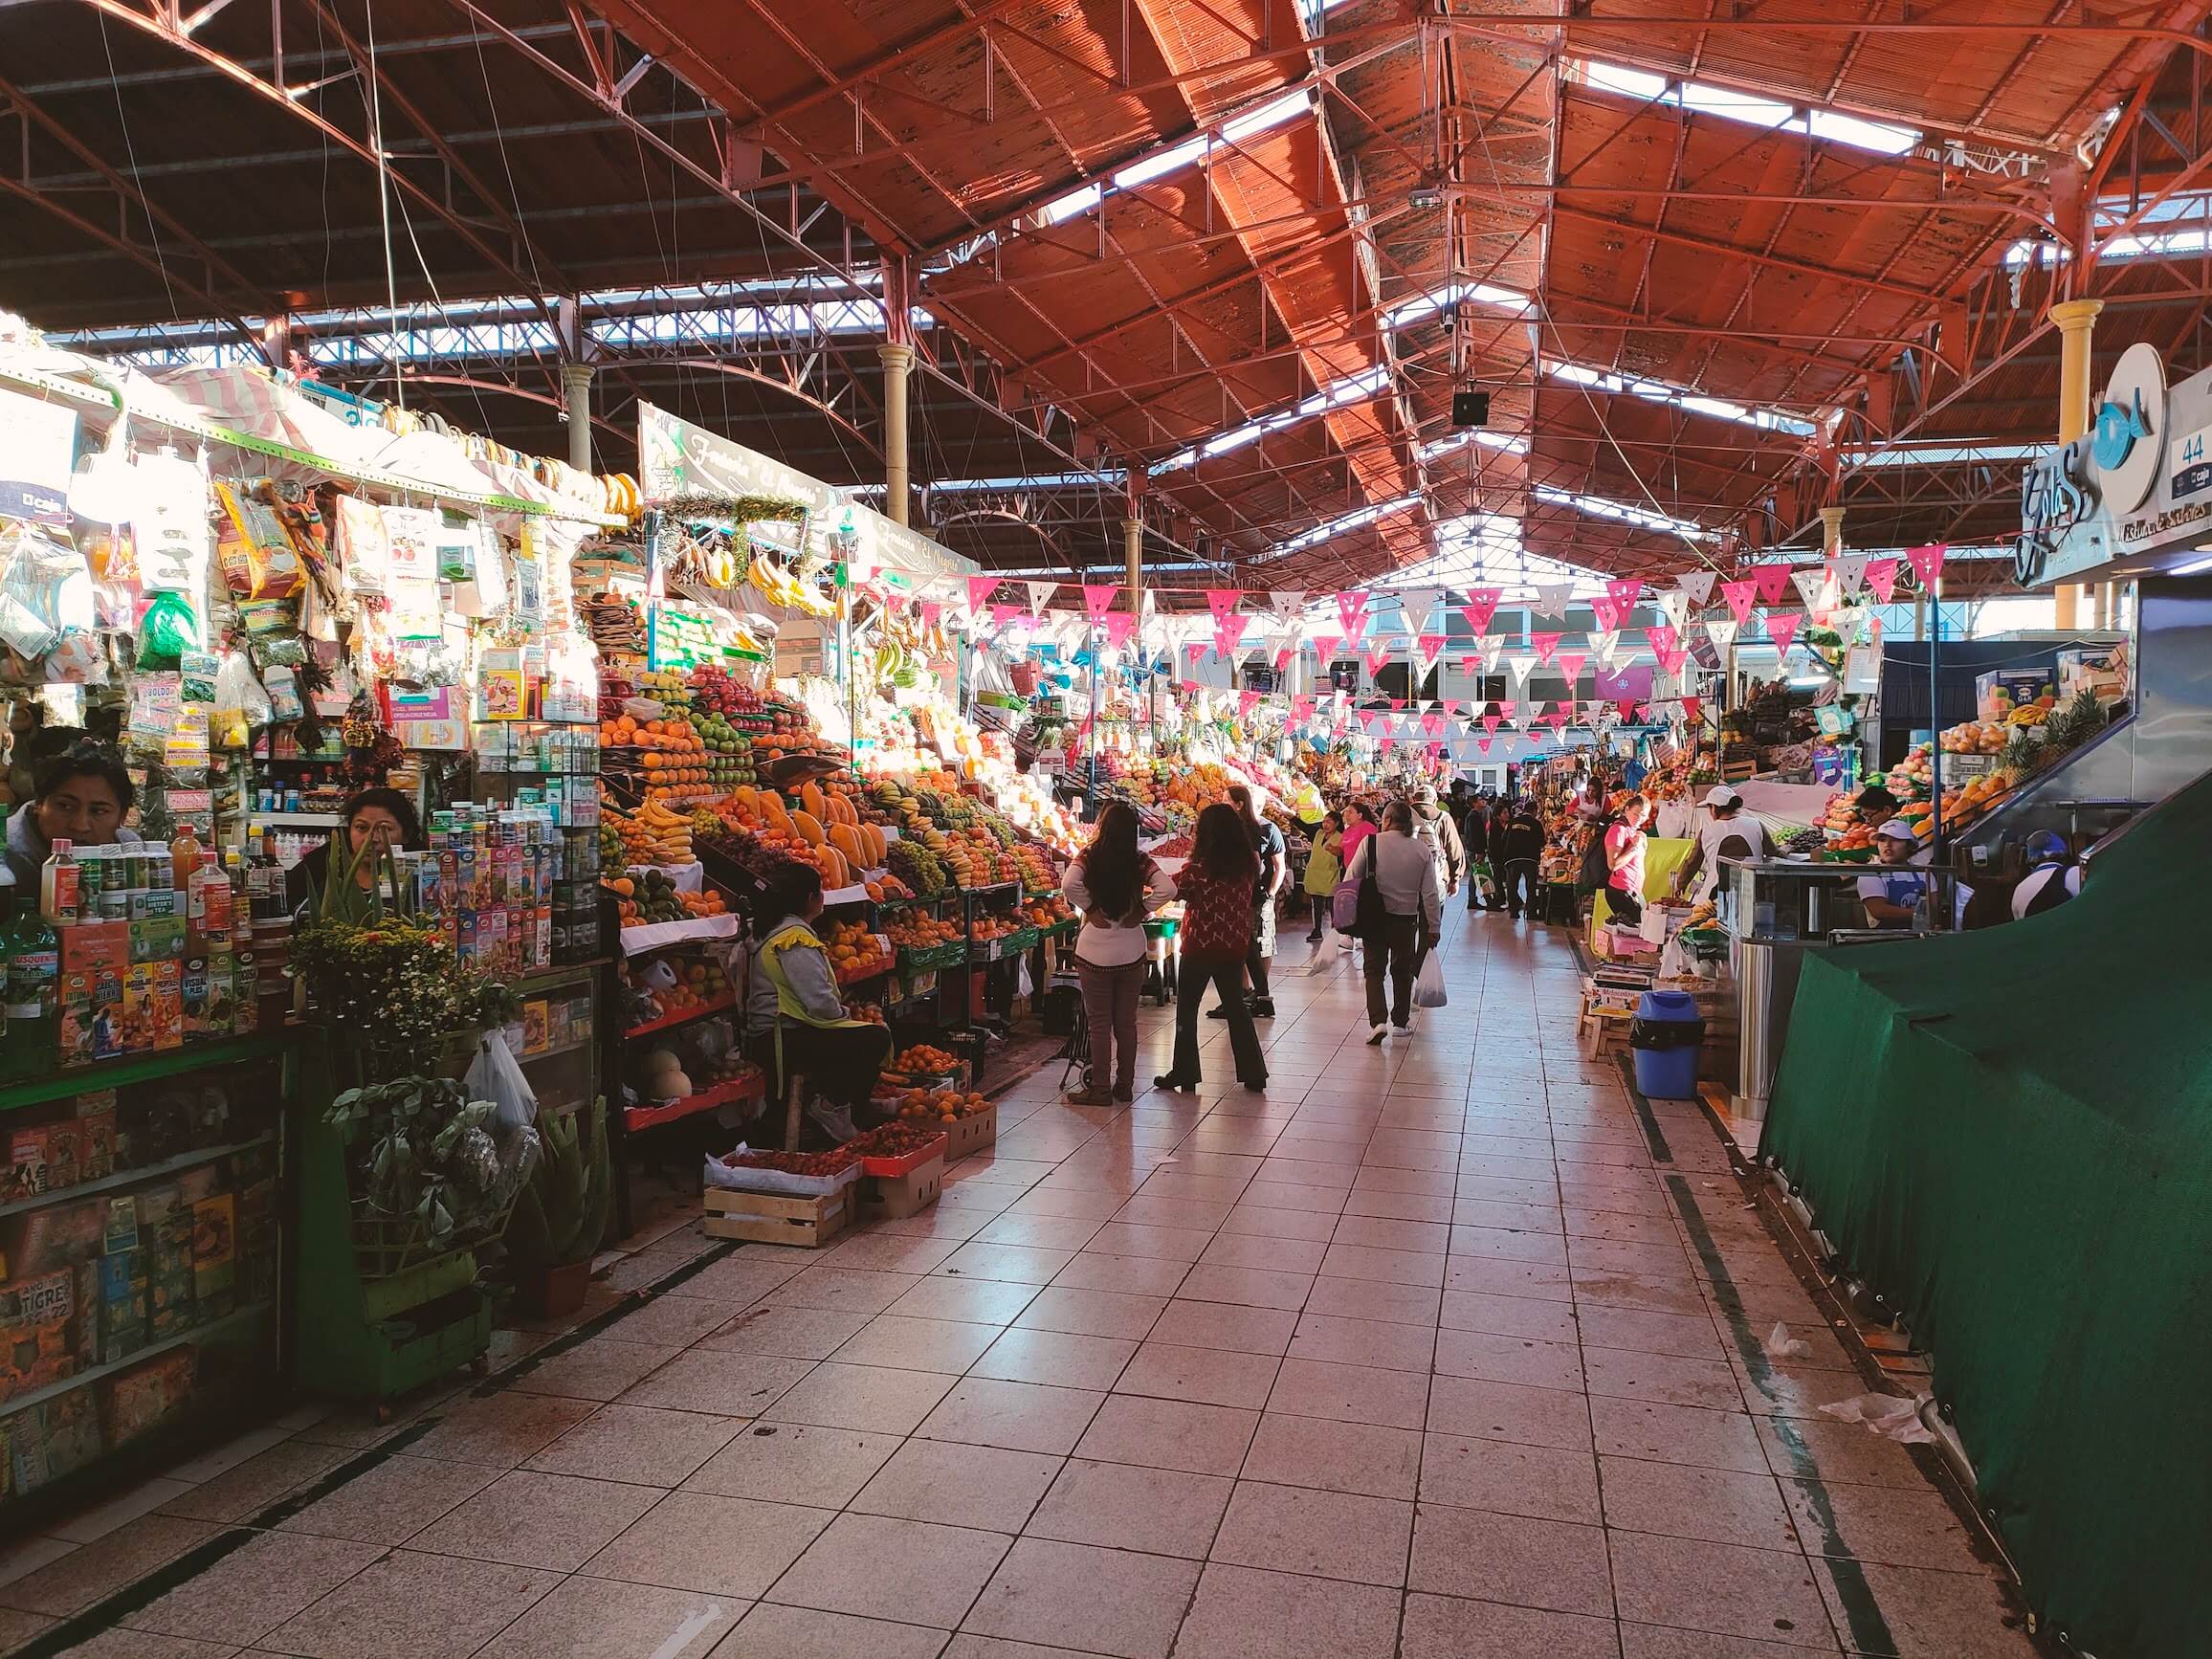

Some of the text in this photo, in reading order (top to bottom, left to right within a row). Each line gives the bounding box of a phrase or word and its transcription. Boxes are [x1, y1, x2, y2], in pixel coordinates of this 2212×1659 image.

[2182, 433, 2203, 464] 44
[147, 687, 170, 697] BOLDO
[21, 1286, 63, 1314] TIGRE
